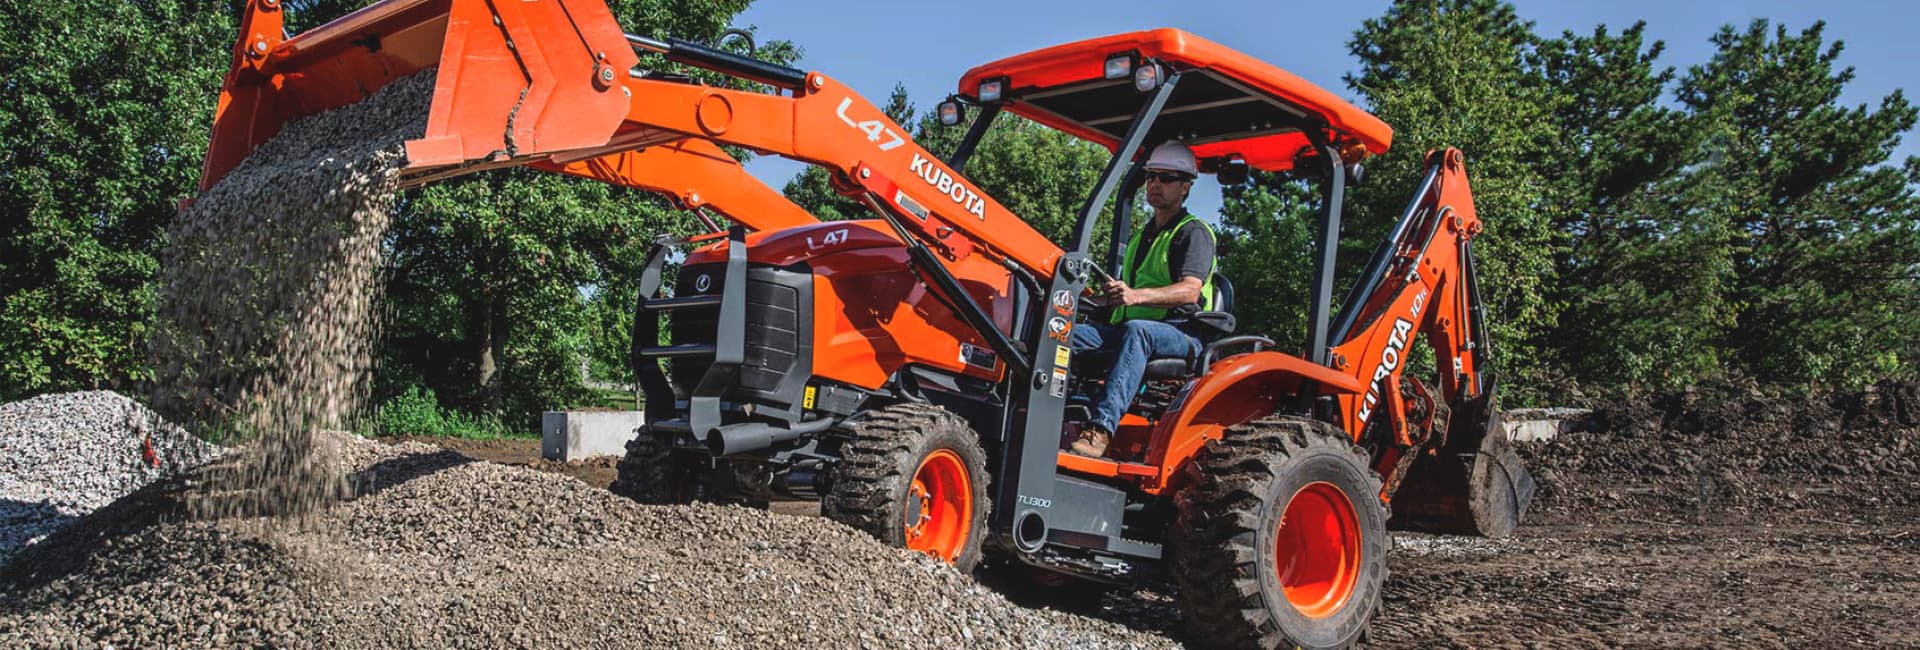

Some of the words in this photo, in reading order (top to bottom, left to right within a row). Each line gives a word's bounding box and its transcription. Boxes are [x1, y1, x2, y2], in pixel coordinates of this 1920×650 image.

[836, 96, 905, 152] L47
[910, 152, 986, 220] KUBOTA
[806, 229, 849, 250] L47
[1357, 317, 1414, 423] KUBOTA
[1018, 495, 1052, 508] TL1300
